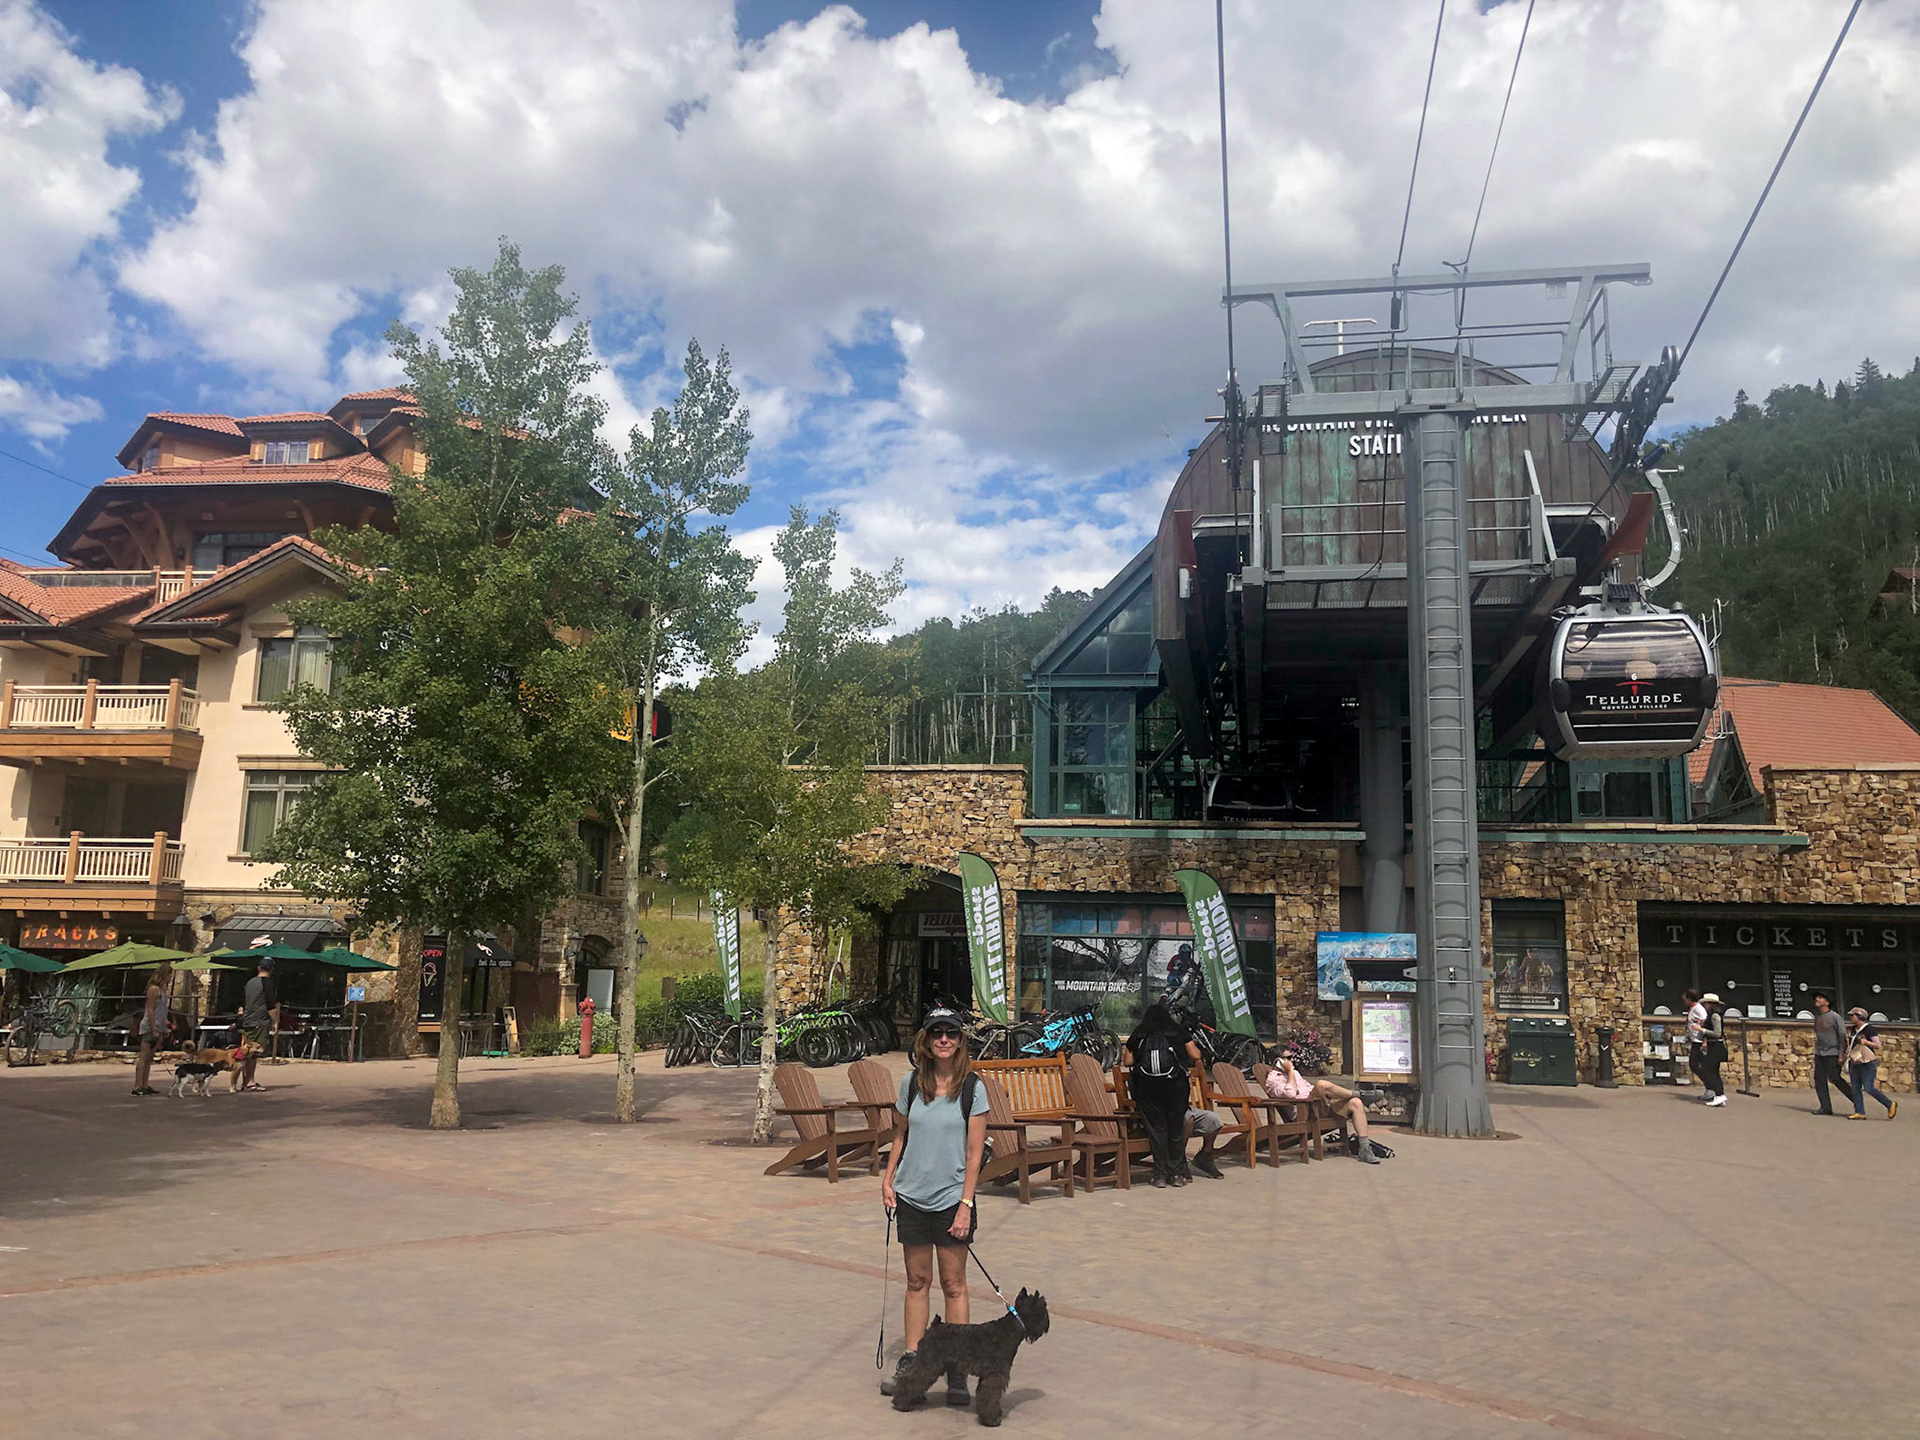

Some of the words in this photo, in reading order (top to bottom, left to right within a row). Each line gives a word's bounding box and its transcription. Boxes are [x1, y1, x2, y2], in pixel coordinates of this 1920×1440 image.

[1350, 434, 1402, 456] STATI
[1631, 673, 1637, 681] 6
[1585, 693, 1683, 706] TELLURIDE
[24, 924, 117, 941] TRACKS
[1666, 925, 1899, 949] TICKETS
[422, 949, 443, 957] OPEN
[1066, 980, 1107, 992] MOUNTAIN
[1107, 982, 1127, 993] BIKE
